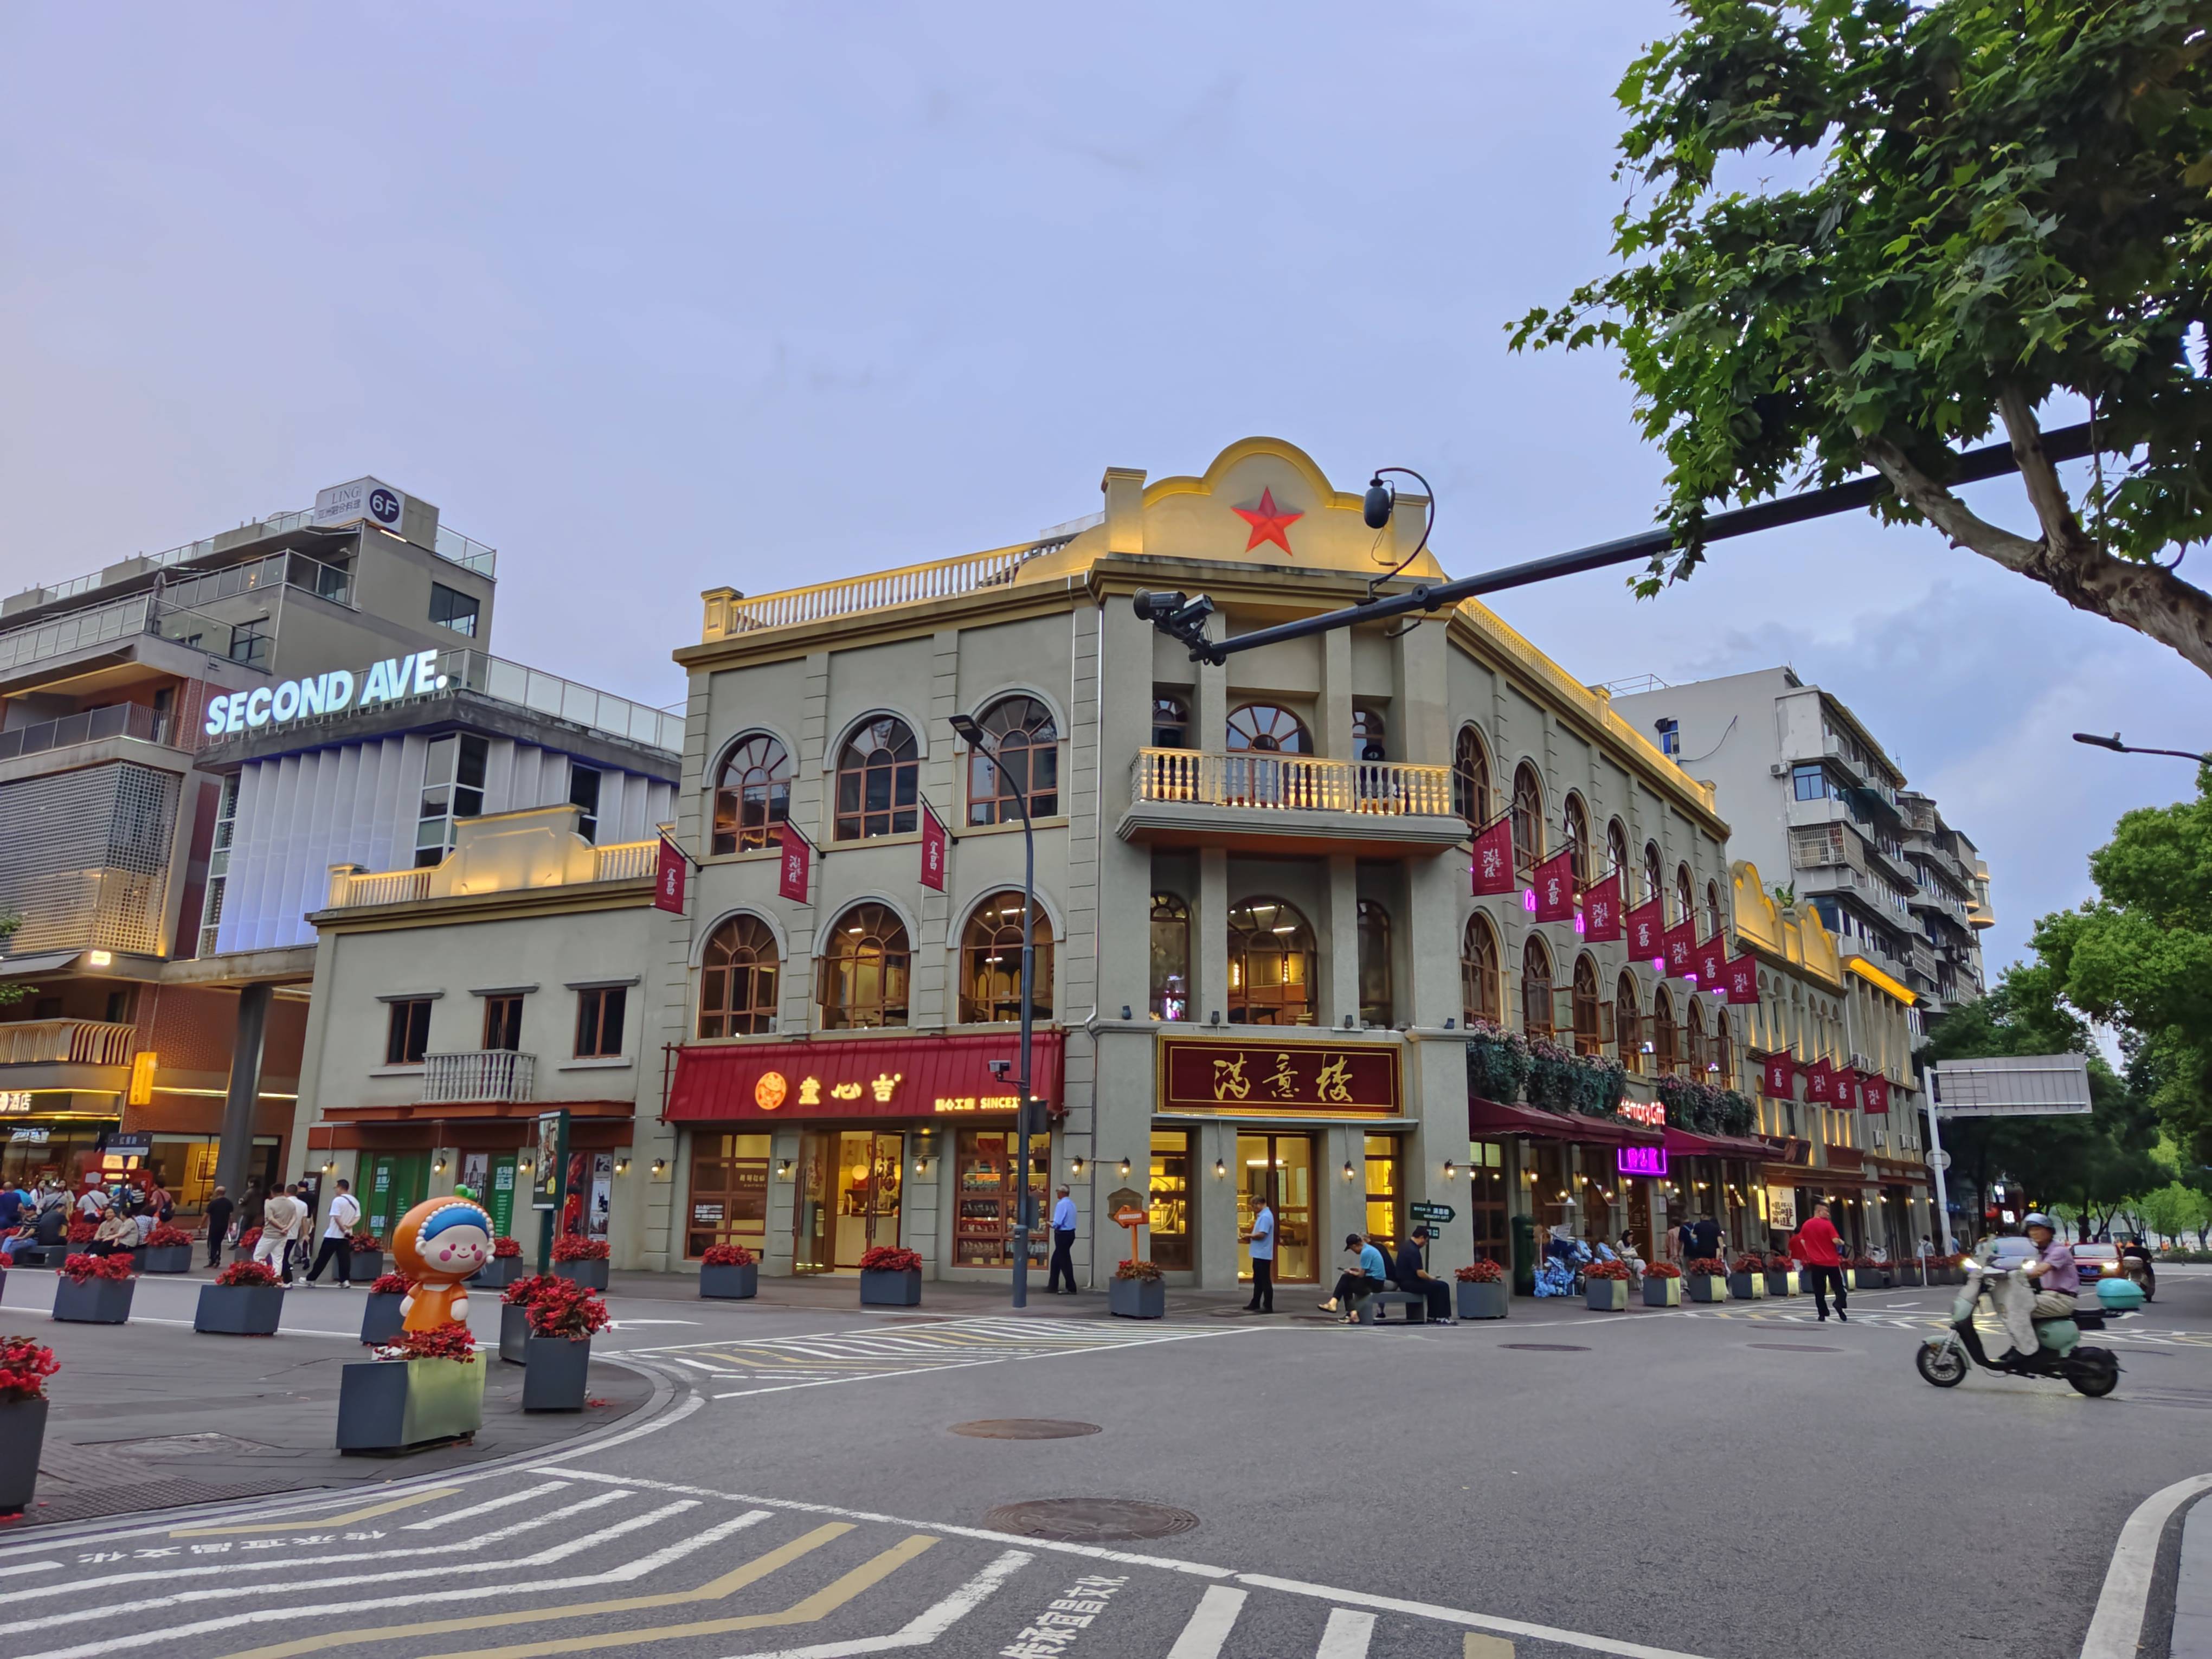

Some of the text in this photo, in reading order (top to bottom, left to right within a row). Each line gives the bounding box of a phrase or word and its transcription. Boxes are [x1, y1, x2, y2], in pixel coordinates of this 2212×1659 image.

[331, 486, 359, 504] LING
[372, 495, 397, 515] 6F
[205, 649, 448, 735] SECOND AVE.
[1547, 878, 1559, 905] 宜昌
[1637, 923, 1650, 947] 宜昌
[798, 1073, 896, 1105] 童心吉
